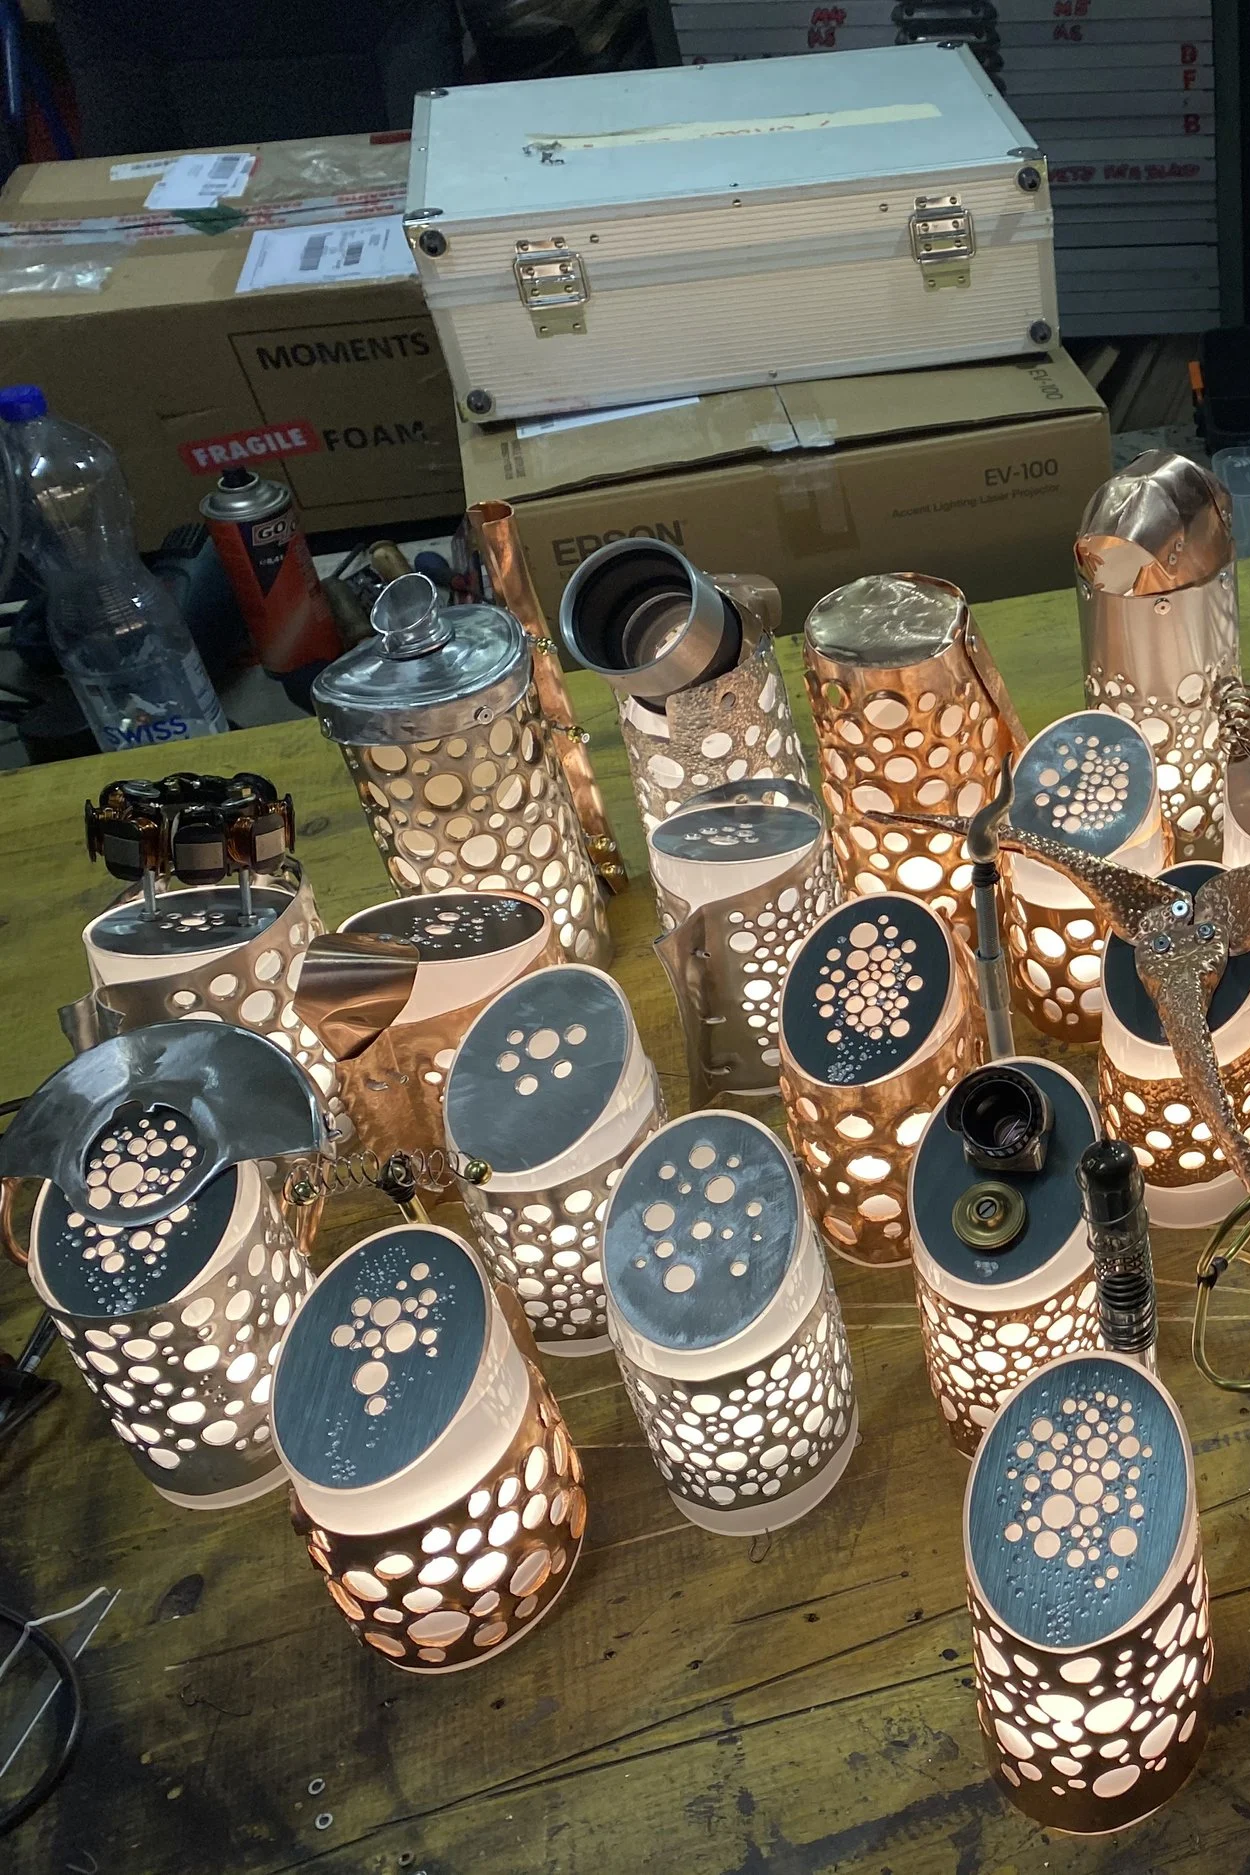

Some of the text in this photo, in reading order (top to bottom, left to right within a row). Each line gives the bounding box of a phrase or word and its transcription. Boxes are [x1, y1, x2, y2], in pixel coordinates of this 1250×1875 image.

[256, 332, 430, 370] MOMENTS
[1029, 369, 1064, 401] EV-100
[191, 427, 307, 467] FRAGILE
[322, 420, 428, 451] FOAM
[984, 458, 1059, 487] EV-100
[891, 483, 1061, 518] Accent Lighting Laser Projector
[103, 714, 188, 746] SWISS
